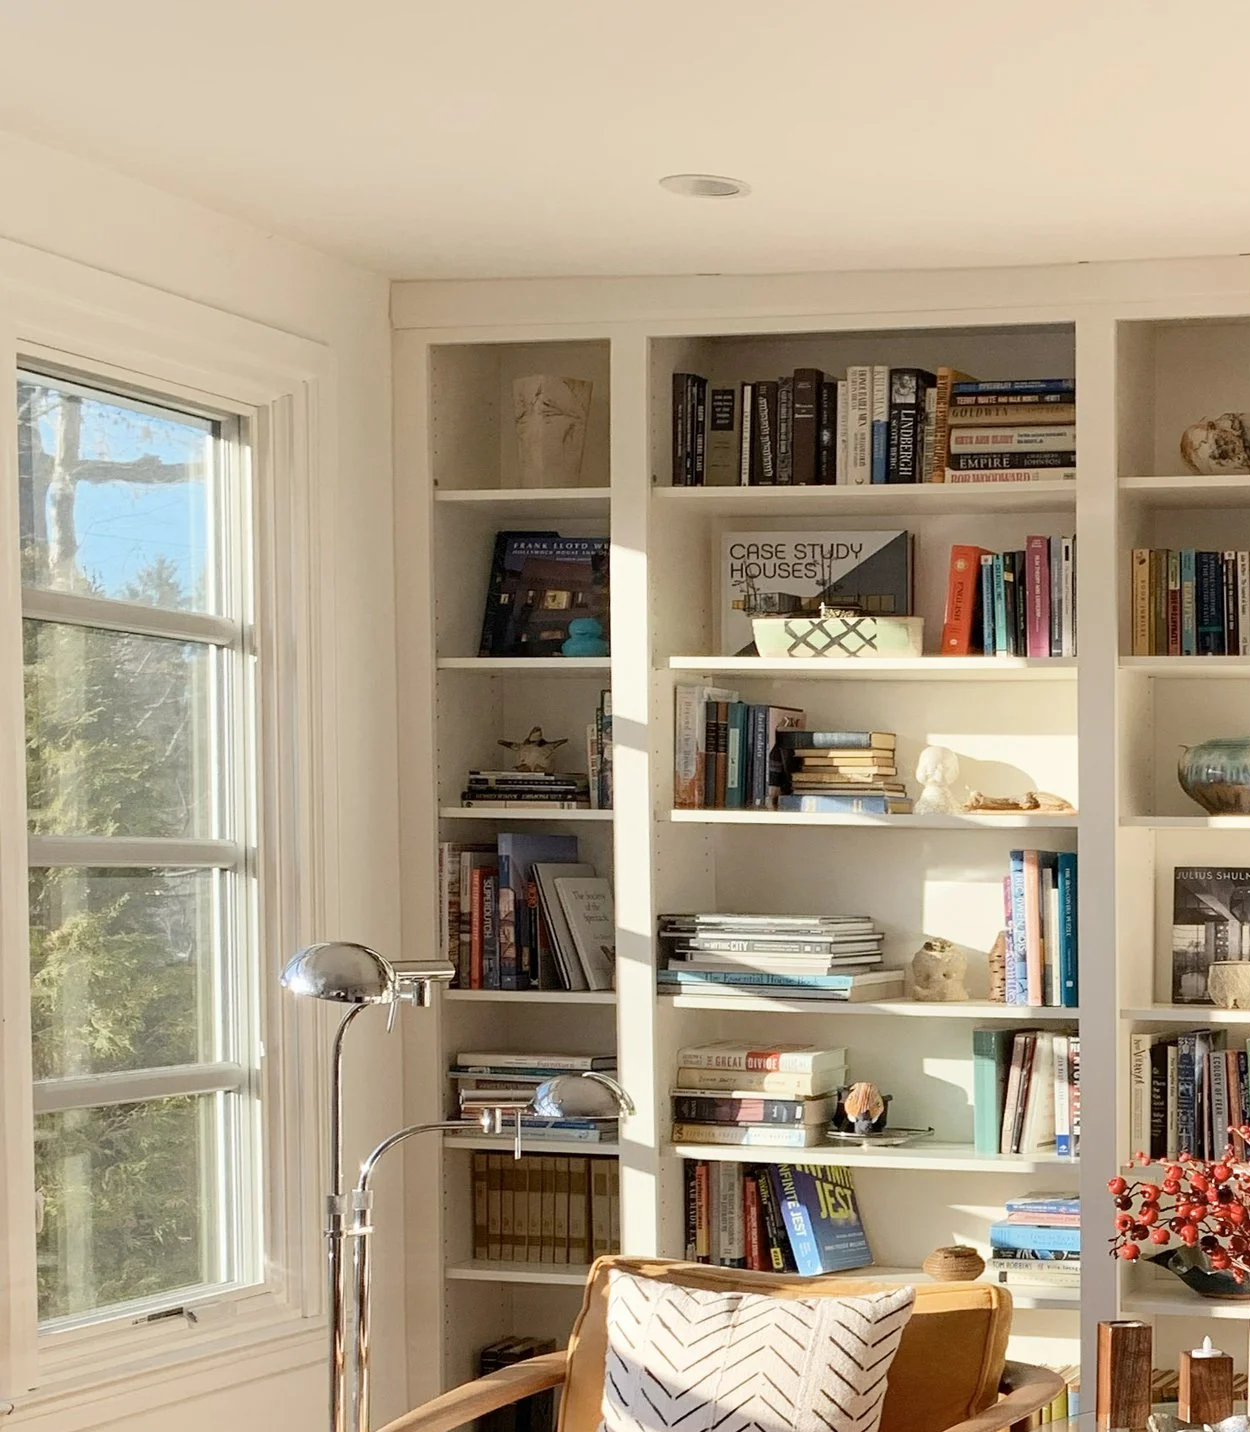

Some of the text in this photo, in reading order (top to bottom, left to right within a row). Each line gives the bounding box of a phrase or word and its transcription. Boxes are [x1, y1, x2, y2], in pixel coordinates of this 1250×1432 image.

[874, 370, 886, 418] KRUGMAN
[951, 406, 1009, 418] GOLDWYN
[889, 419, 898, 446] SCOTT
[898, 409, 916, 476] LINDBERGH
[889, 447, 898, 470] BERG
[959, 458, 1011, 469] EMPIRE
[513, 542, 548, 550] FRANK
[553, 542, 589, 550] LLOYD
[729, 542, 863, 560] CASE STUDY
[730, 562, 817, 579] HOUSES
[953, 581, 965, 621] ENGLISH
[757, 712, 766, 758] david sedaris
[1175, 870, 1213, 881] JULIUS
[483, 879, 493, 939] SUPERDUTCH
[1015, 897, 1025, 925] OWEN
[730, 940, 749, 952] CITY
[704, 972, 721, 983] The
[723, 972, 764, 983] Essential
[766, 973, 795, 985] House
[715, 1056, 743, 1068] GREAT
[747, 1057, 779, 1070] DIVIDE
[1212, 1056, 1222, 1086] ECOLOGY
[1214, 1088, 1222, 1097] OF
[1215, 1099, 1223, 1116] FEAR
[689, 1180, 697, 1225] WAR MADE
[778, 1163, 808, 1237] NFINITE JEST
[815, 1180, 856, 1220] JEST
[992, 1260, 1006, 1269] TOM
